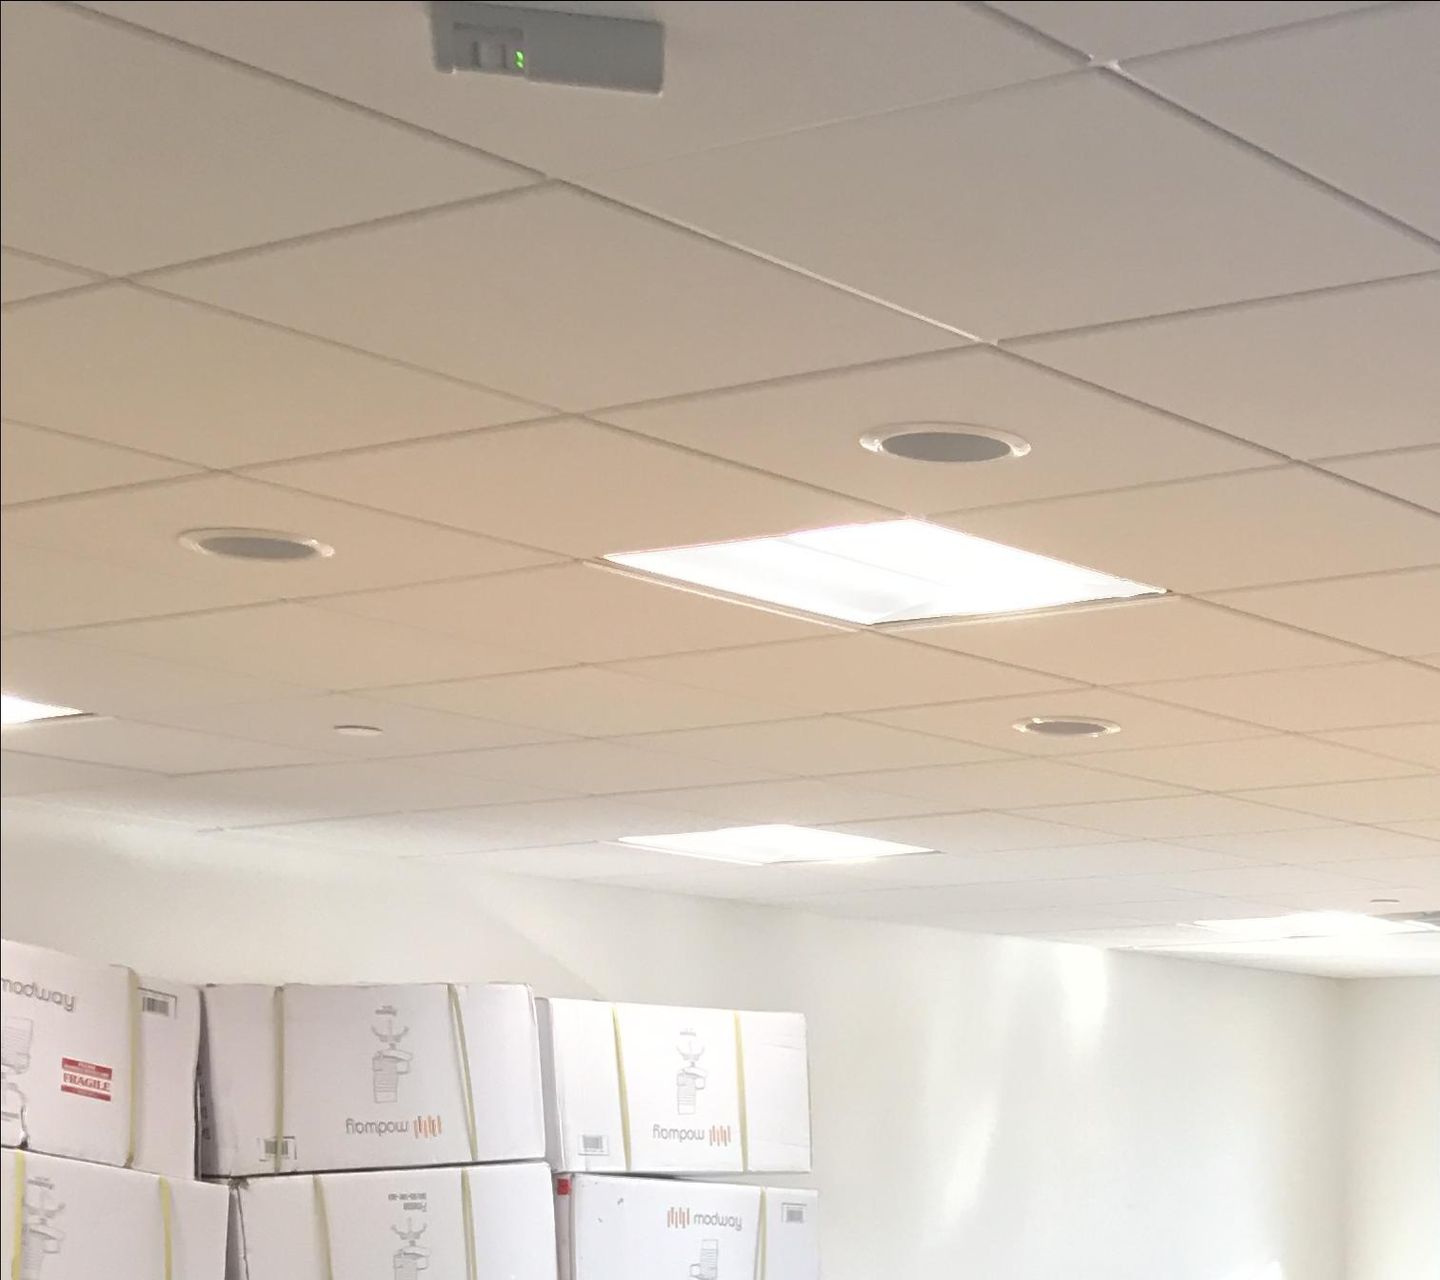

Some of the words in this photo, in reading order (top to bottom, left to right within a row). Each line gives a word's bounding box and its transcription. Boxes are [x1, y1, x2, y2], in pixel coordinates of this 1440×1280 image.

[63, 1072, 111, 1091] FRAGILE
[345, 1118, 409, 1136] modway
[652, 1124, 705, 1142] modway
[693, 1212, 743, 1231] modway
